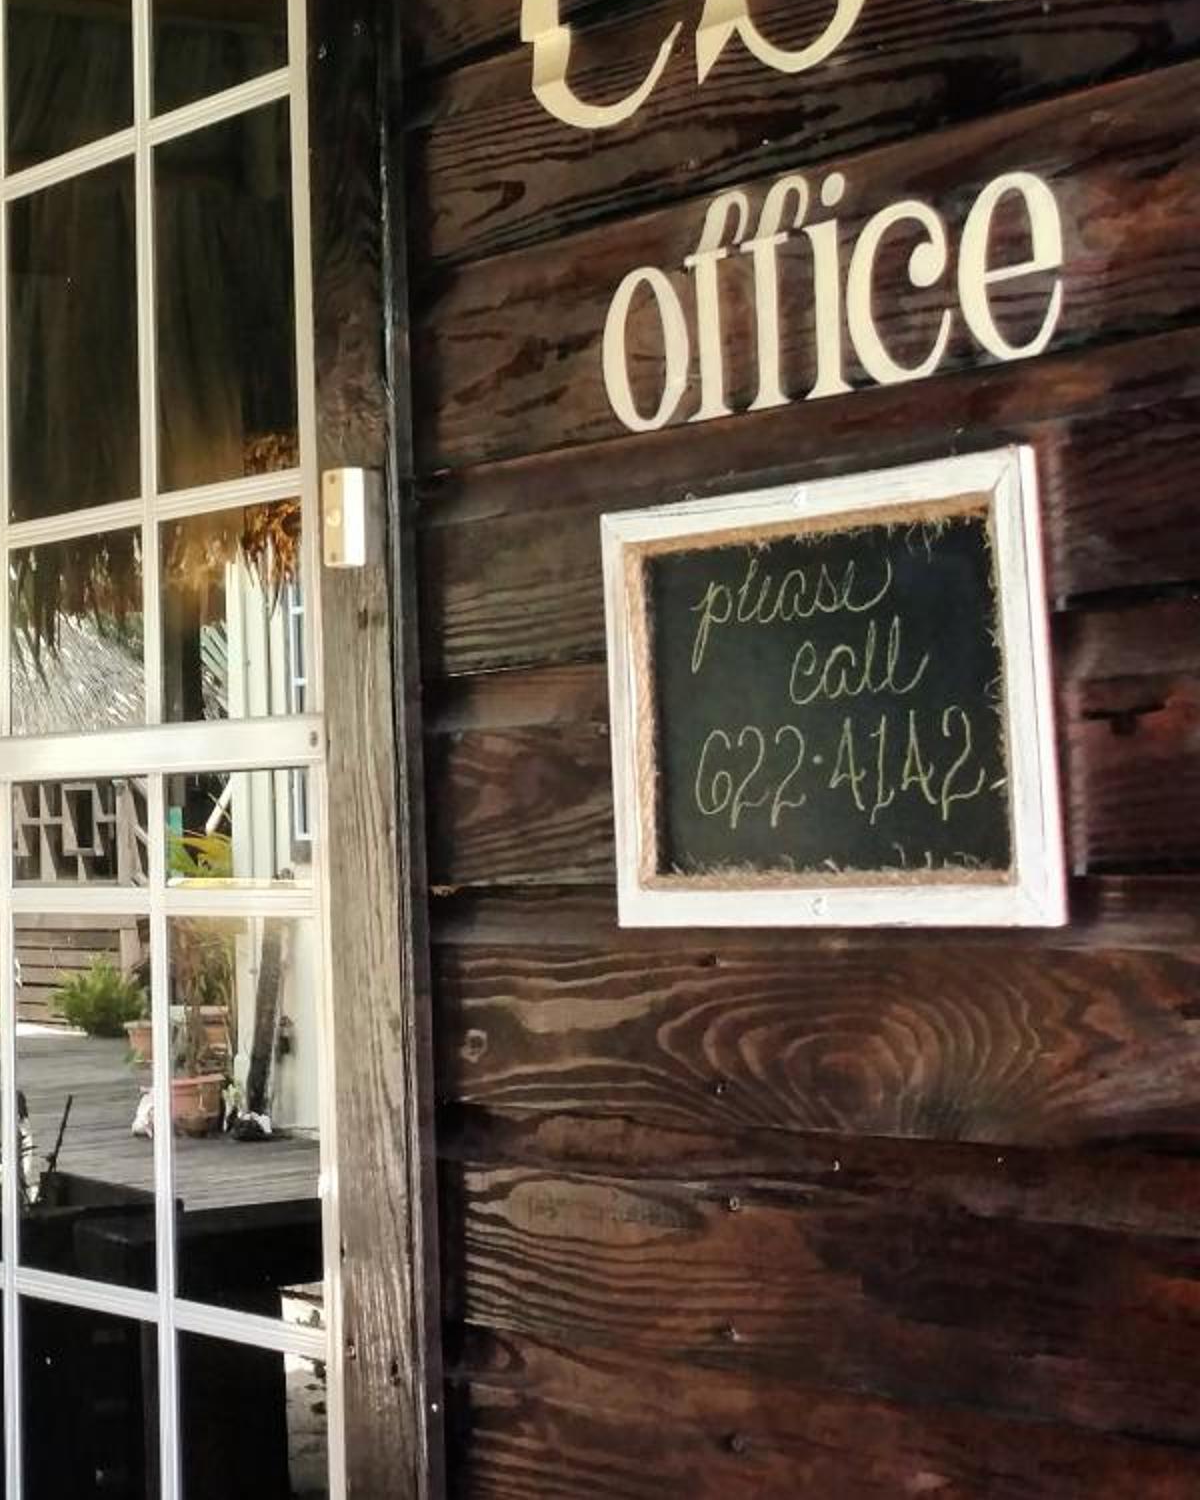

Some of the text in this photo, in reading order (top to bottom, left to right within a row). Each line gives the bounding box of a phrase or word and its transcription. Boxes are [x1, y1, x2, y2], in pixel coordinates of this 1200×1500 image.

[602, 171, 1064, 433] office
[690, 557, 893, 674] please
[789, 615, 931, 706] call
